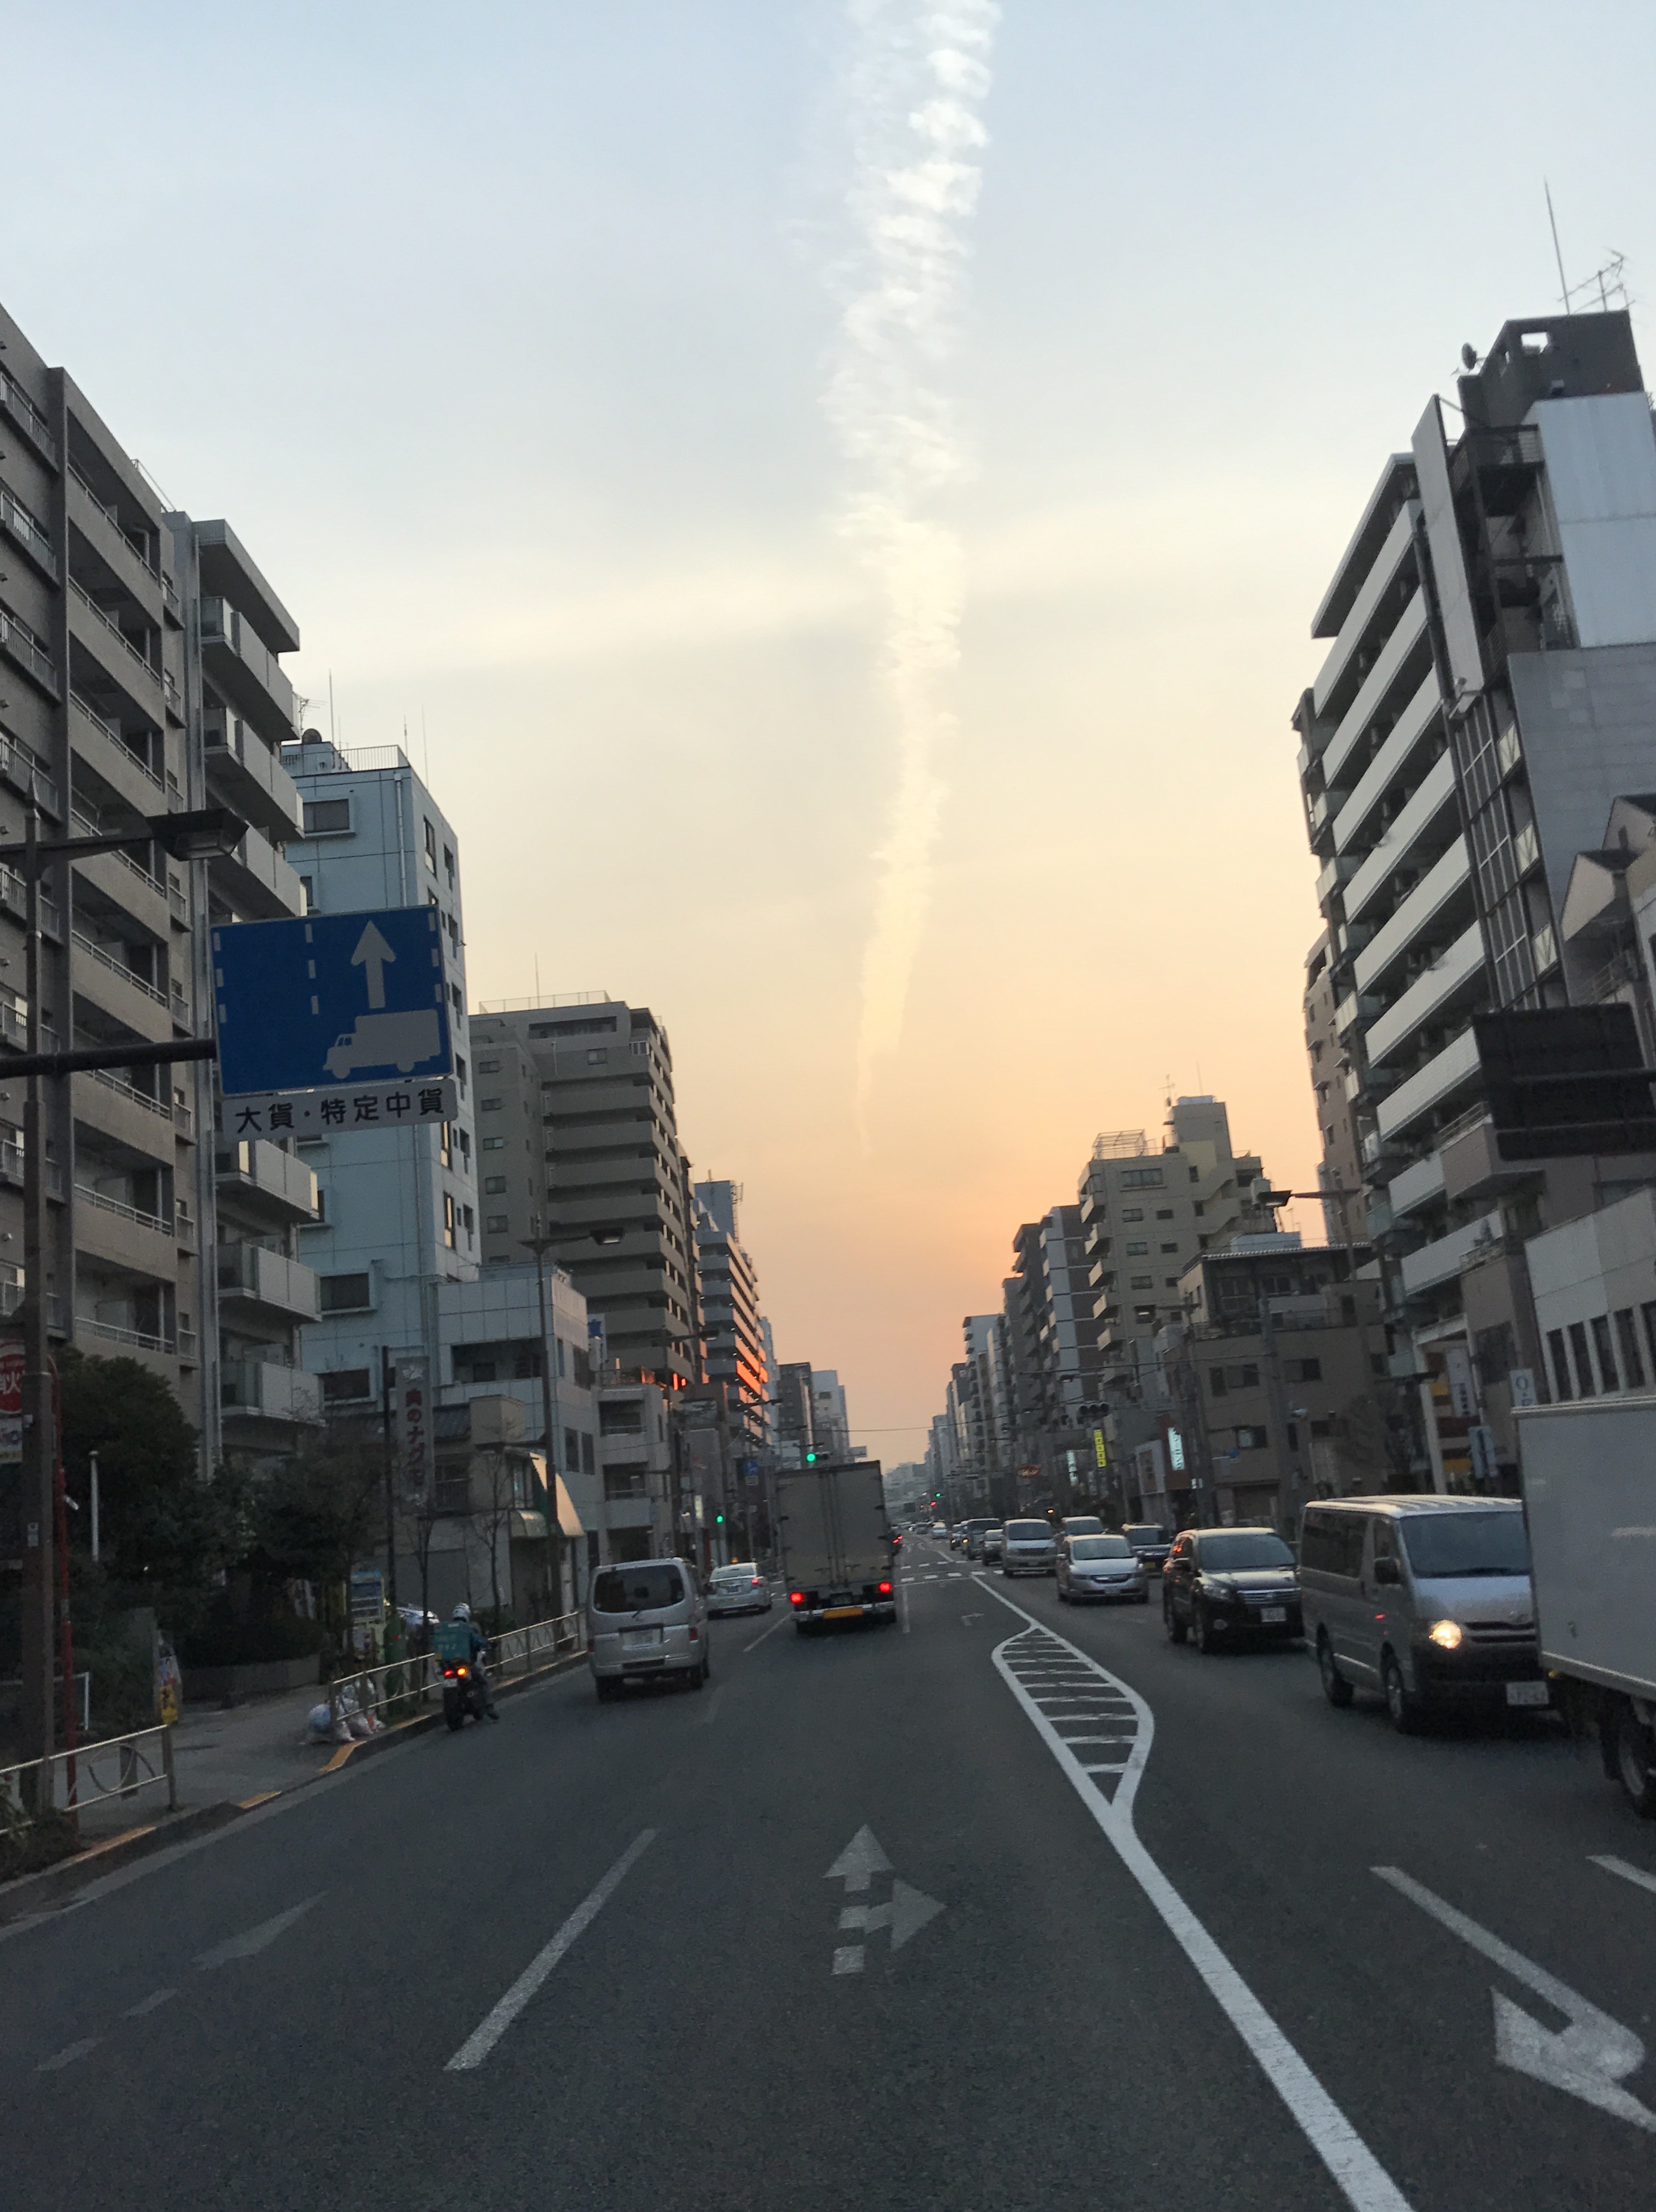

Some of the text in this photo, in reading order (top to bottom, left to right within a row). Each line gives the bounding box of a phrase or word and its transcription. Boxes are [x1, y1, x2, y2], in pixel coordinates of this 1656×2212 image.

[236, 1087, 444, 1134] 大貨・特定中貨
